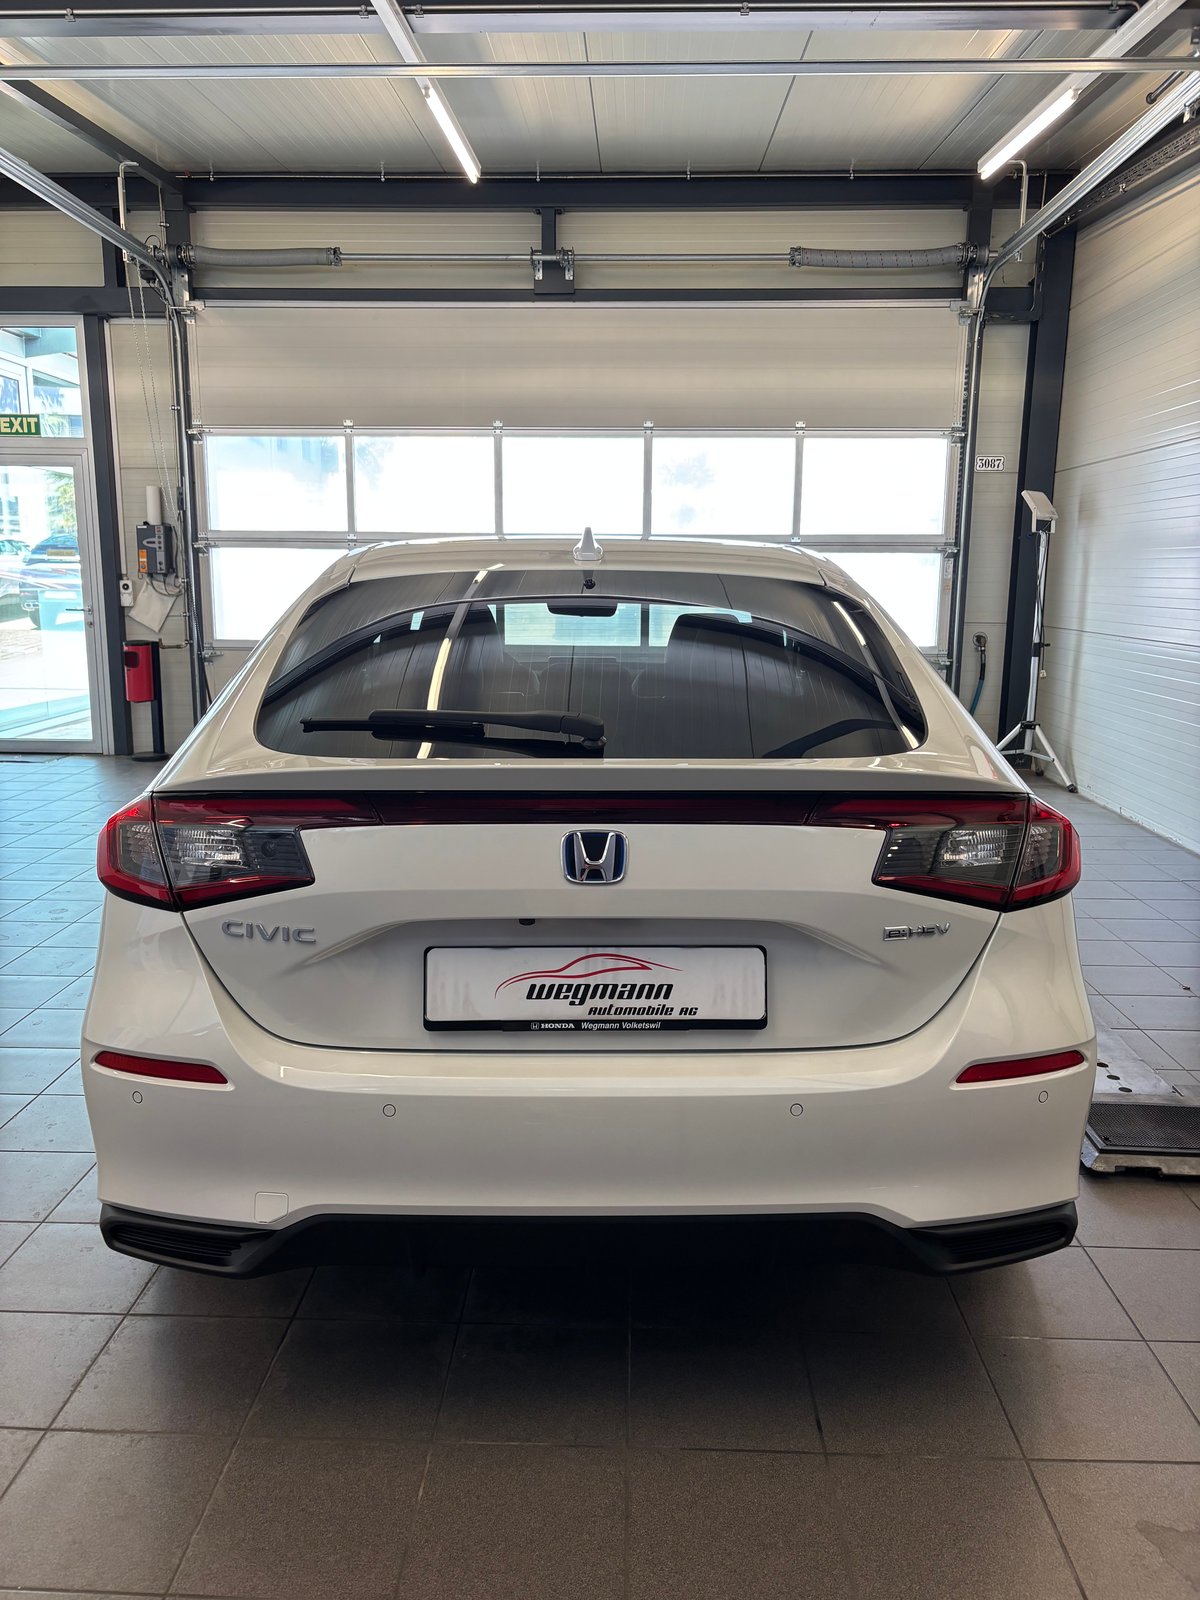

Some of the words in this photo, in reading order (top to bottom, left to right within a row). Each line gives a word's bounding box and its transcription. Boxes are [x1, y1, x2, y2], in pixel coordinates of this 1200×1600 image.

[0, 417, 38, 433] EXIT
[978, 458, 1002, 469] 3087
[221, 920, 317, 943] CIVIC
[526, 983, 674, 1006] wegmann
[679, 1007, 699, 1016] AG
[581, 1021, 620, 1031] Wegmann
[621, 1021, 661, 1029] Volketswil
